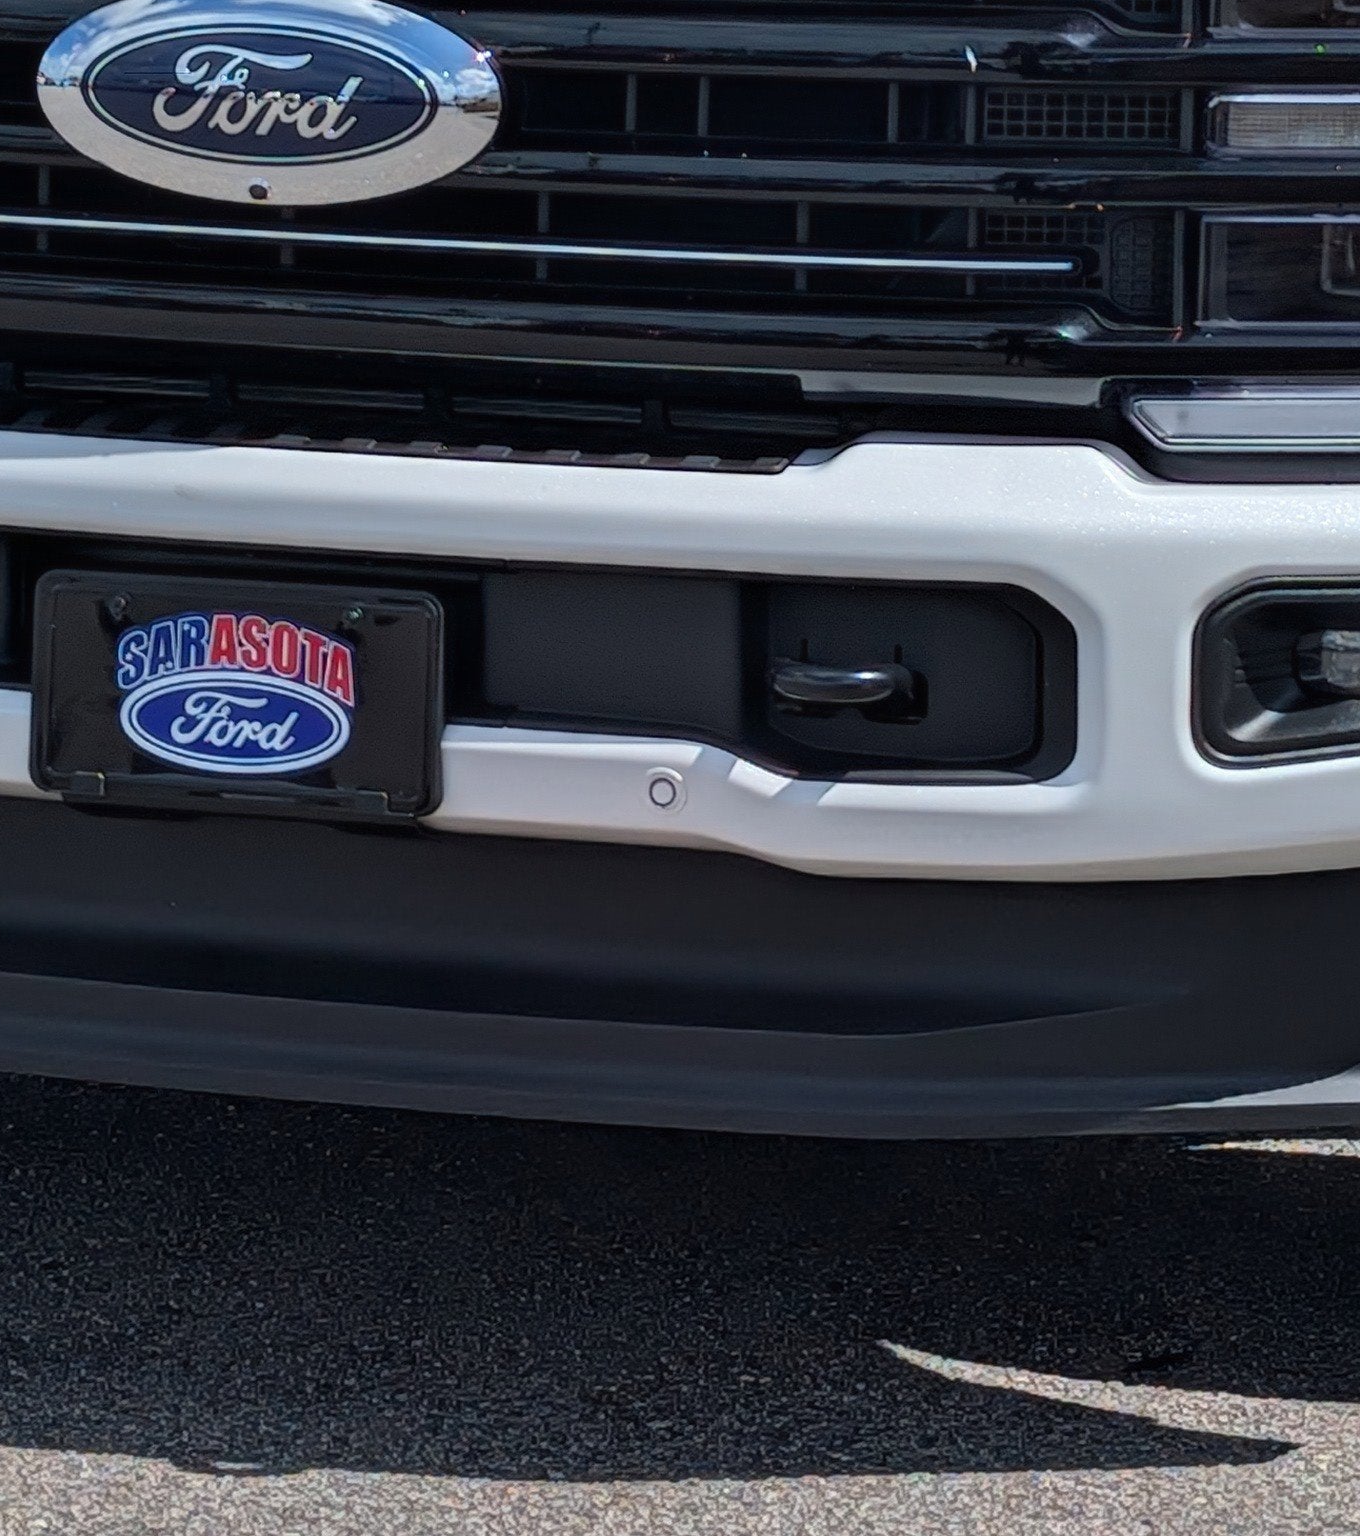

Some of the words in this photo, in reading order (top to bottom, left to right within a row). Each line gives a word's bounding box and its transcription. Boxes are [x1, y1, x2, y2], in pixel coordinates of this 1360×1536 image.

[152, 42, 364, 141] Ford
[116, 613, 356, 708] SARASOTA
[170, 690, 297, 752] Ford
